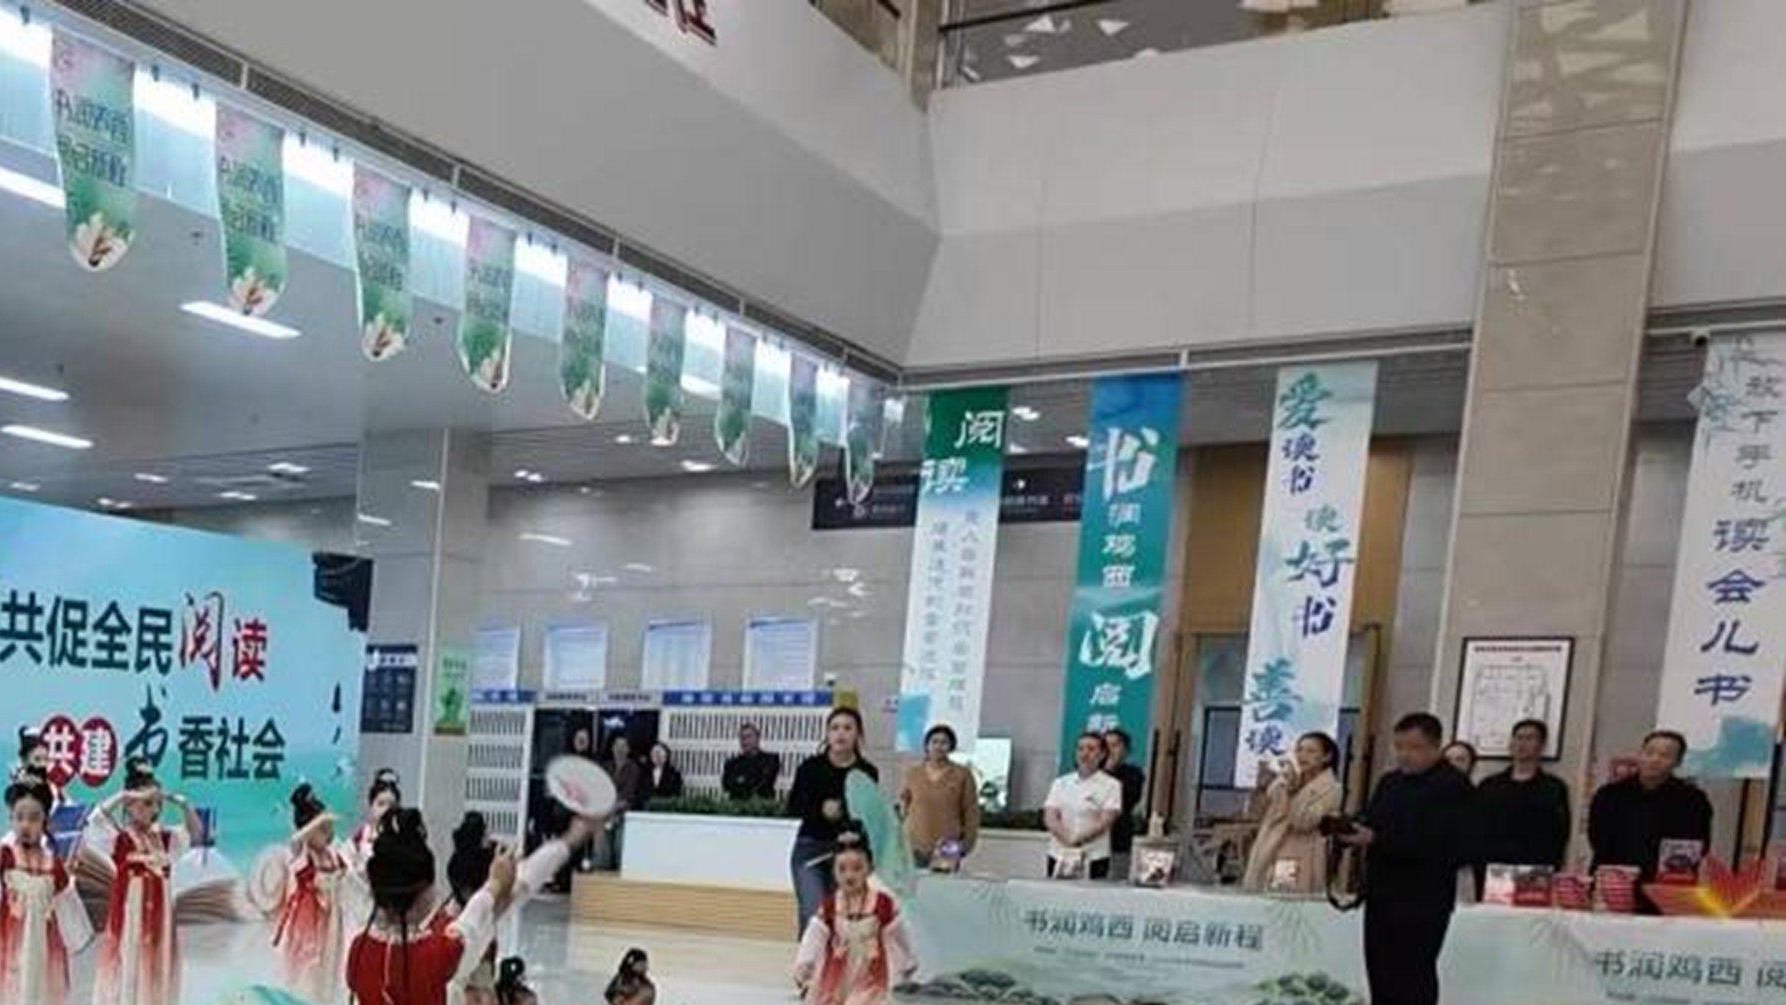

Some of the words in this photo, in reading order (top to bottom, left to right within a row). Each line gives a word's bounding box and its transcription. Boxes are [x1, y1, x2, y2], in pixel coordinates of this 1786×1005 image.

[41, 685, 286, 781] 共建书香社会
[1024, 909, 1134, 941] 书润鸡西
[1143, 916, 1263, 951] 阅启新程
[1595, 949, 1742, 985] 书润鸡西
